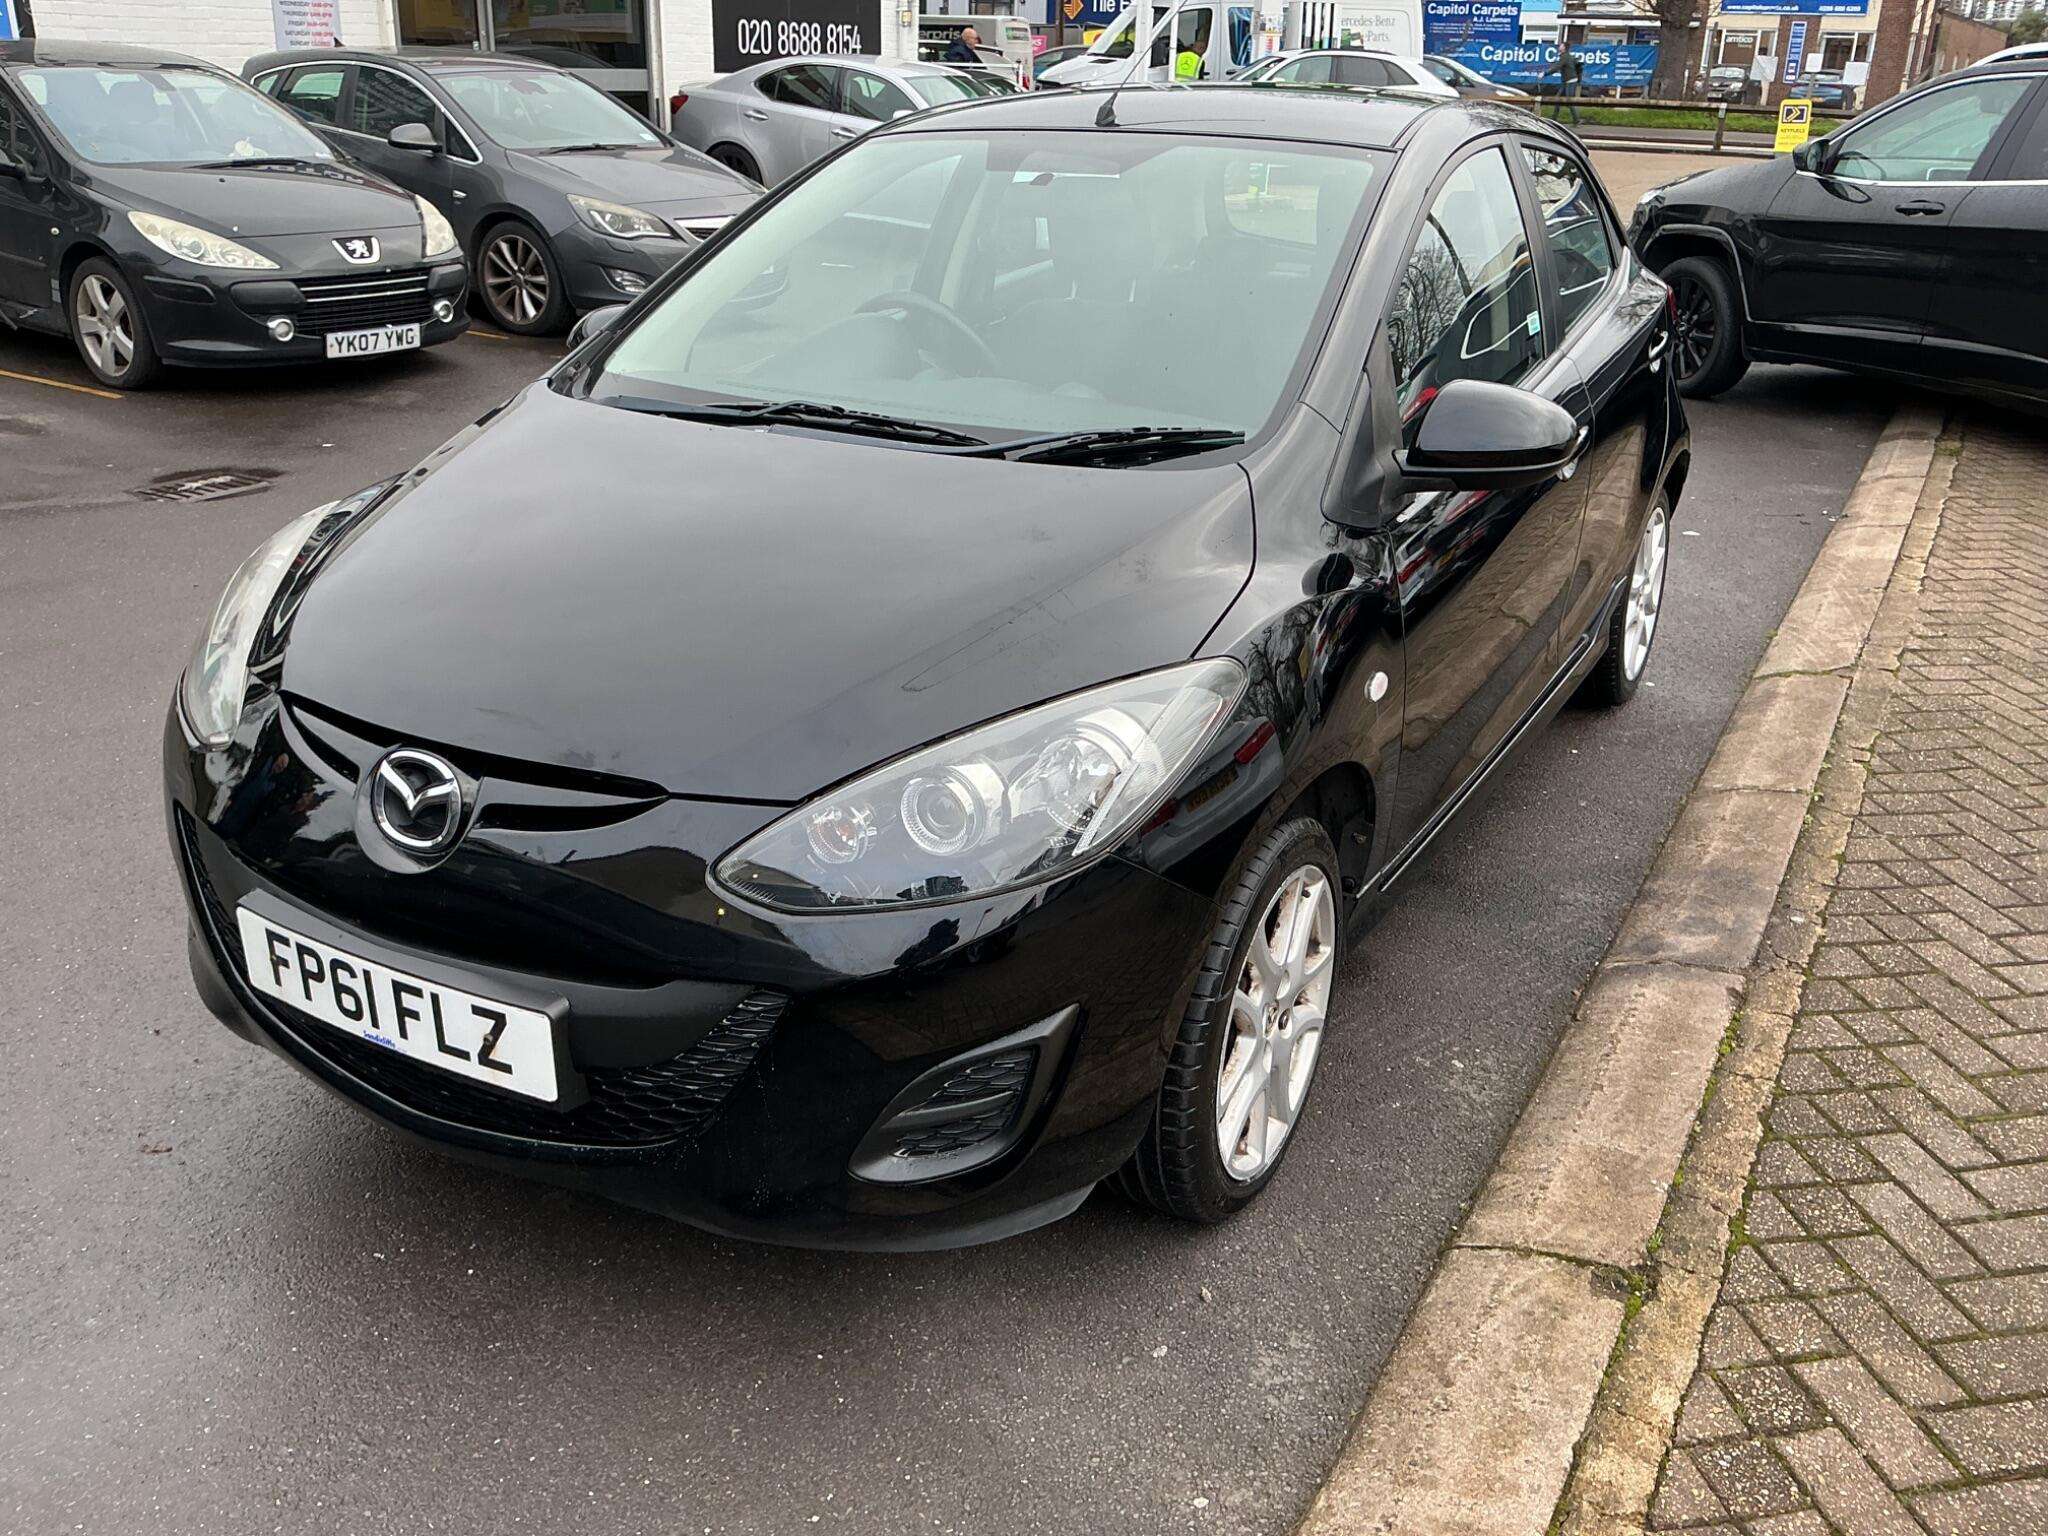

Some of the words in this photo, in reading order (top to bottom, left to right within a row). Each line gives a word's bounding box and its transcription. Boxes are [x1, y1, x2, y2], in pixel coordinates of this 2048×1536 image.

[1341, 15, 1396, 27] ercedes-Benz
[1427, 3, 1470, 17] Capitol
[1472, 4, 1519, 17] Carpets
[737, 19, 772, 55] 020
[777, 20, 822, 56] 8688
[826, 23, 863, 55] 8154
[1481, 46, 1540, 64] Capitol
[1545, 47, 1611, 64] Cpets
[335, 333, 380, 354] YK07
[385, 328, 414, 349] YWG
[265, 928, 381, 1031] FP61
[391, 978, 513, 1075] FLZ
